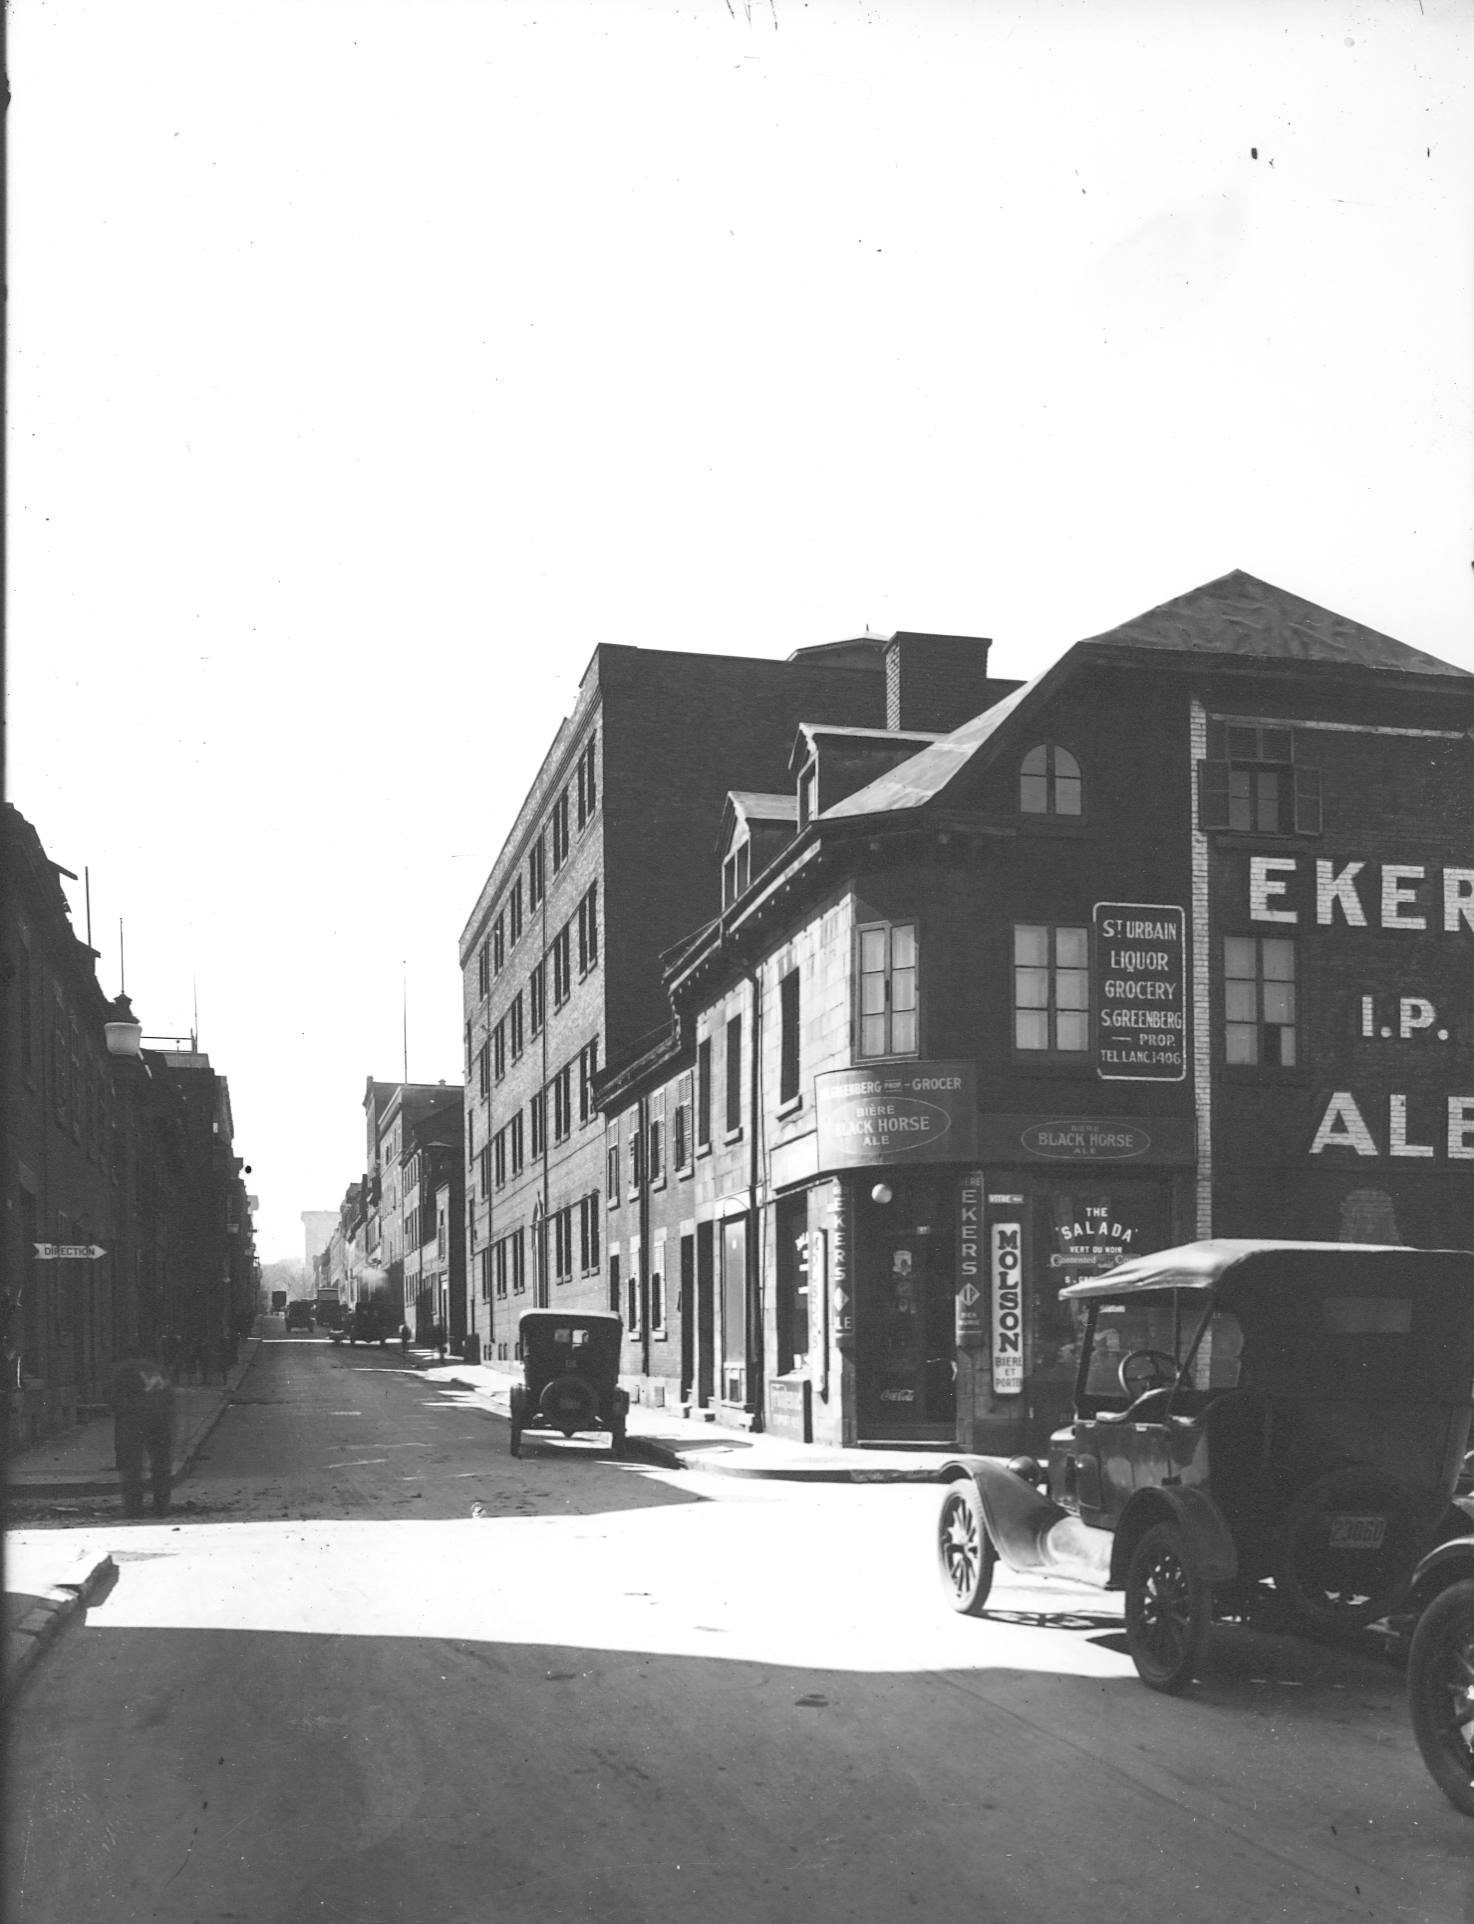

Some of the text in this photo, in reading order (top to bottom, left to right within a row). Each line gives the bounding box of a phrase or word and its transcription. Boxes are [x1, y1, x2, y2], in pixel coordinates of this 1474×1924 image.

[1126, 920, 1177, 941] URBAIN
[1110, 949, 1169, 972] LIQUOR
[1104, 979, 1177, 1000] GROCERY
[1362, 995, 1449, 1041] I.P.
[878, 1116, 930, 1133] HORSE
[863, 1135, 890, 1147] ALE
[1038, 1132, 1135, 1148] BLACK HORSE
[1073, 1147, 1097, 1155] ALE
[1085, 1207, 1109, 1217] THE
[961, 1189, 978, 1275] EKERS
[44, 1247, 96, 1256] DIRECTION
[998, 1230, 1020, 1353] MOLSON
[995, 1356, 1023, 1368] BIERE
[1005, 1368, 1016, 1376] ET
